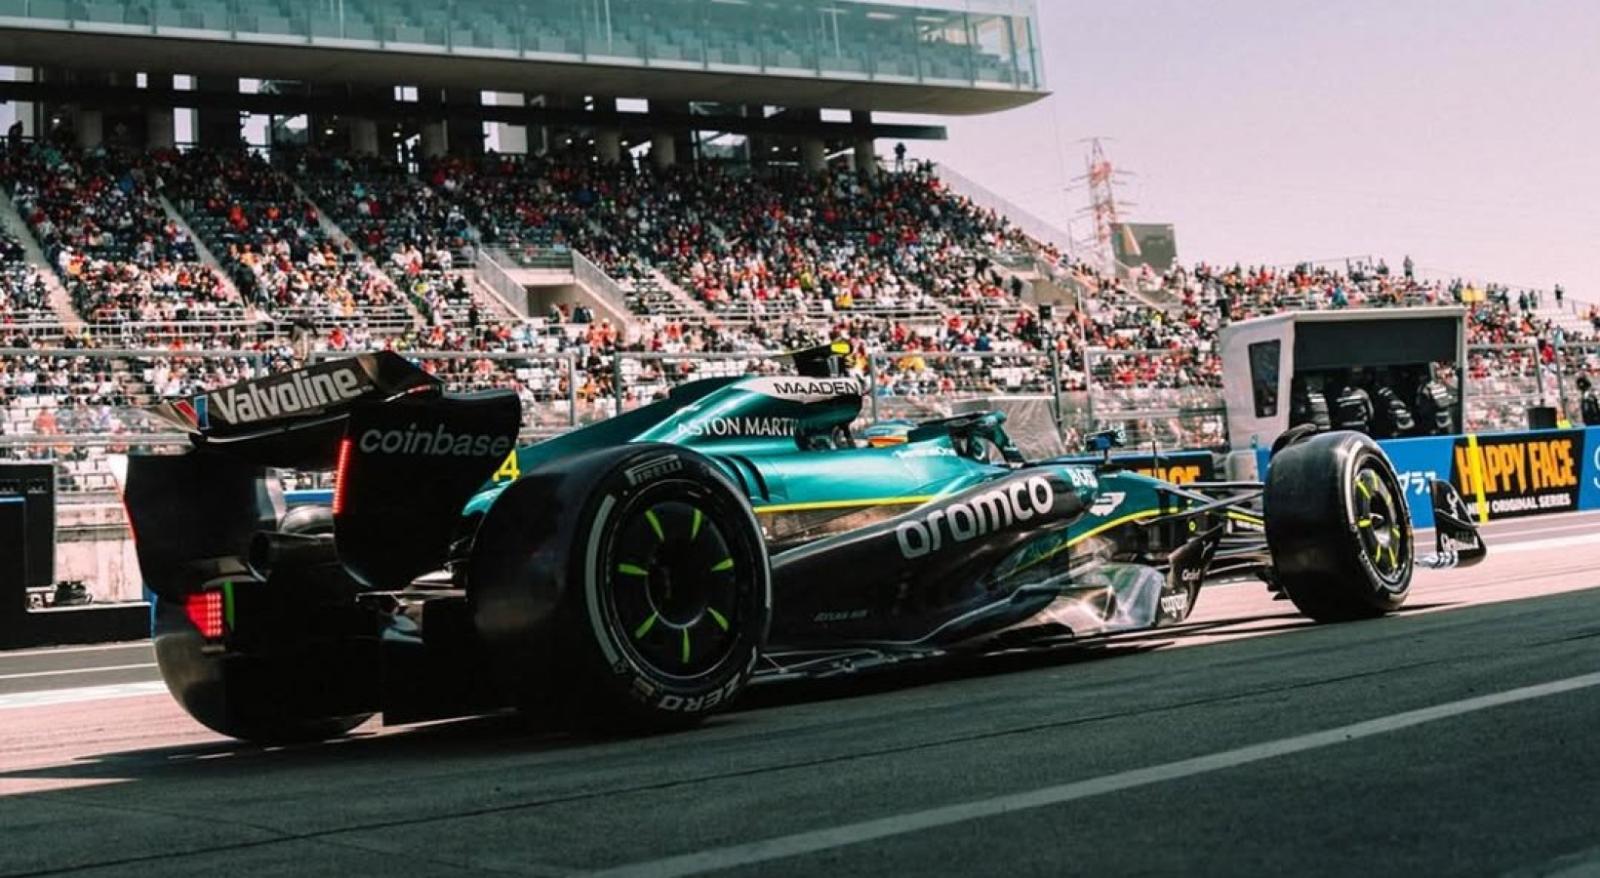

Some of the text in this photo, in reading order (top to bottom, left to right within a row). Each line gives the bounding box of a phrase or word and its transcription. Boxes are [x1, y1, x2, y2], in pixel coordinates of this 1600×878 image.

[211, 367, 362, 425] Valvoline
[773, 381, 860, 395] MAADEN
[359, 421, 510, 456] coinbase
[678, 416, 740, 435] ASTON
[1528, 439, 1577, 491] FACE
[896, 476, 1054, 559] aramco
[1538, 492, 1571, 508] SERIES
